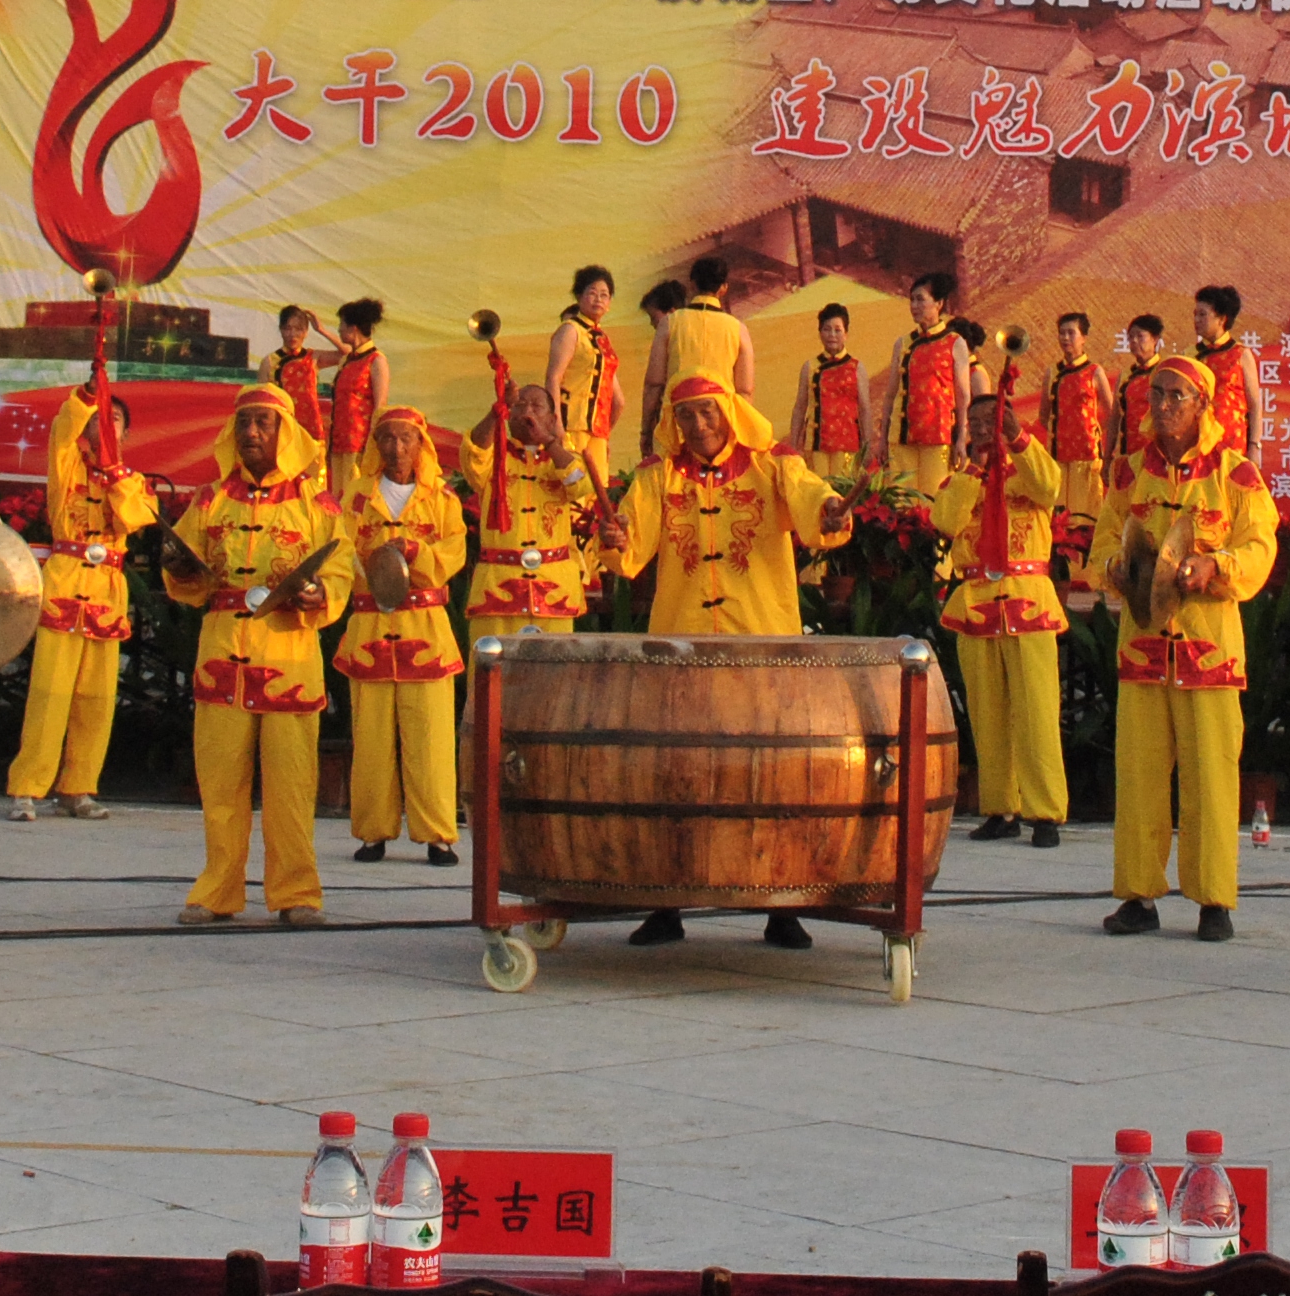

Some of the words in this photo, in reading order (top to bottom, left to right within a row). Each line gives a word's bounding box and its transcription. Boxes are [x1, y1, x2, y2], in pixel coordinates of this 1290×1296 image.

[220, 46, 679, 148] 大干2010
[441, 1174, 596, 1237] 李吉国
